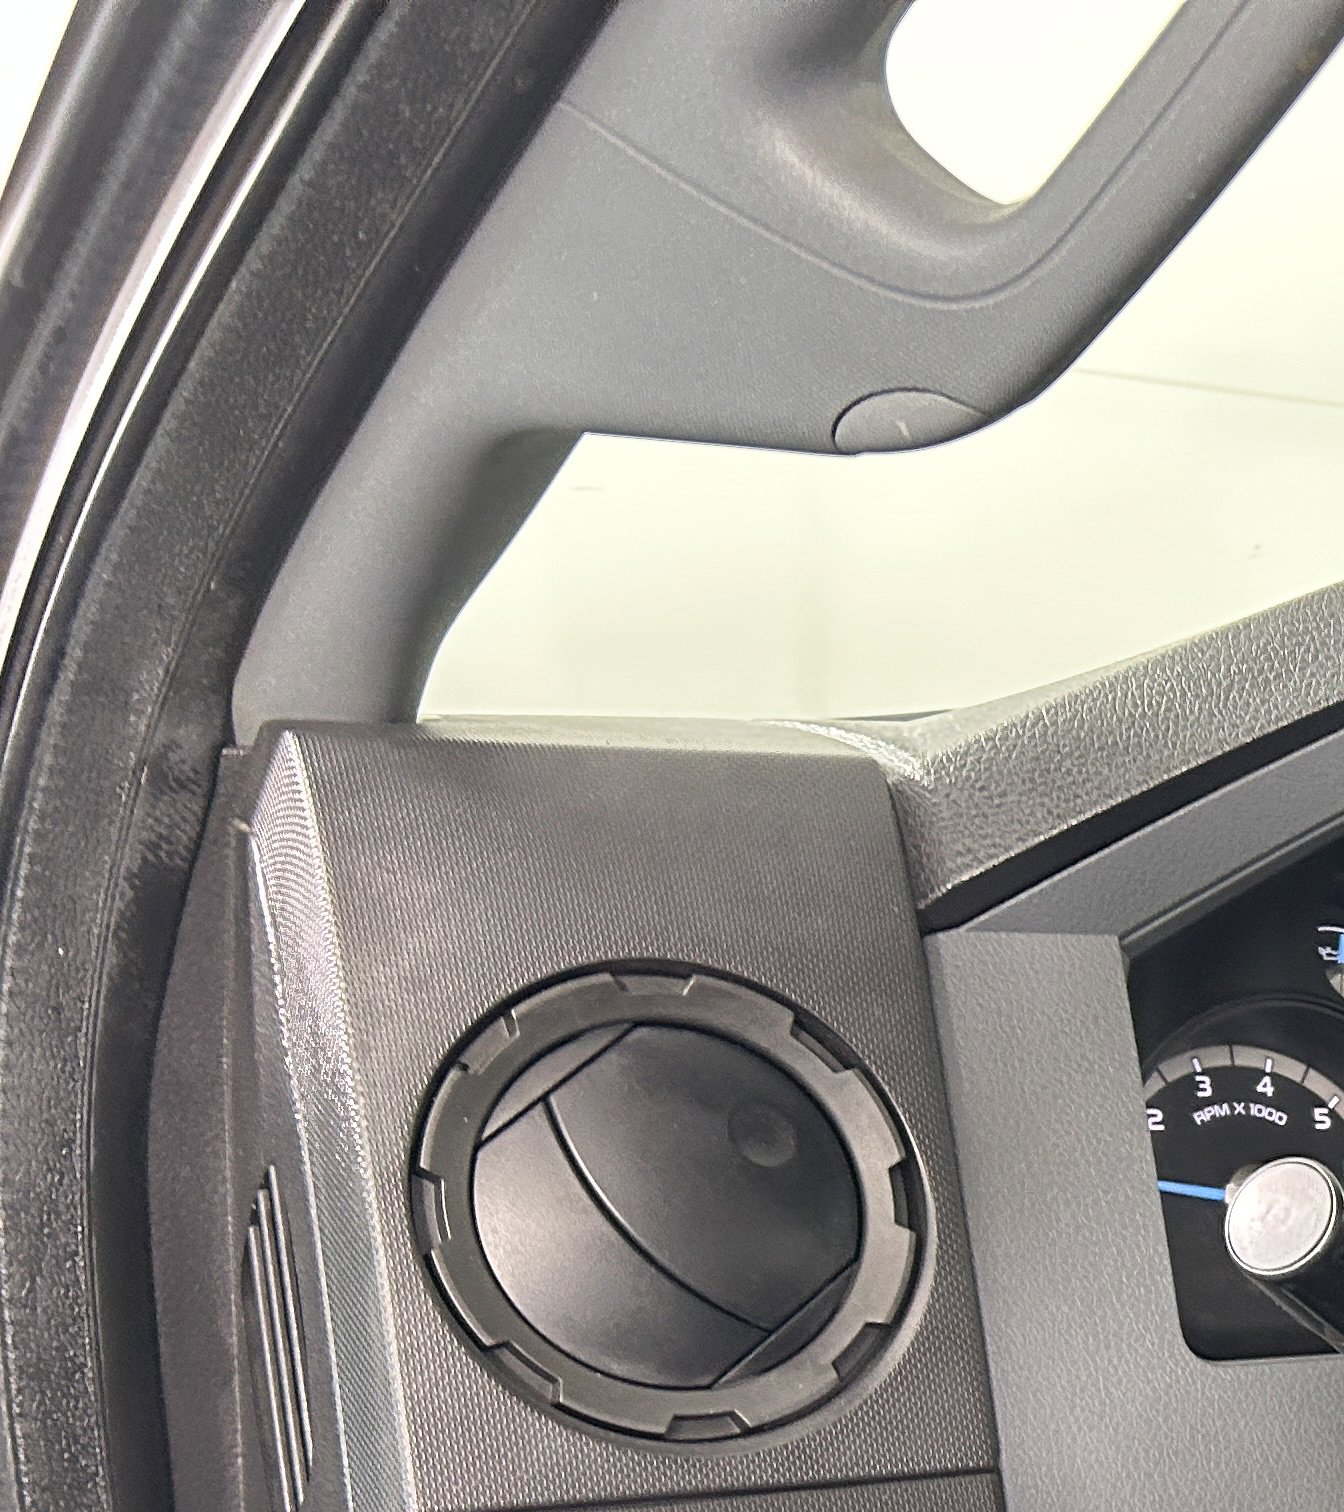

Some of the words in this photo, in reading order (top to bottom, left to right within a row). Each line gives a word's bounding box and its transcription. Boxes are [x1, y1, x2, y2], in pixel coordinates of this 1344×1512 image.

[1195, 1075, 1212, 1097] 3
[1256, 1075, 1274, 1097] 4
[1146, 1109, 1165, 1130] 2
[1192, 1102, 1231, 1126] RPM
[1234, 1102, 1246, 1115] X
[1250, 1102, 1287, 1126] 1000
[1313, 1108, 1331, 1130] 5
